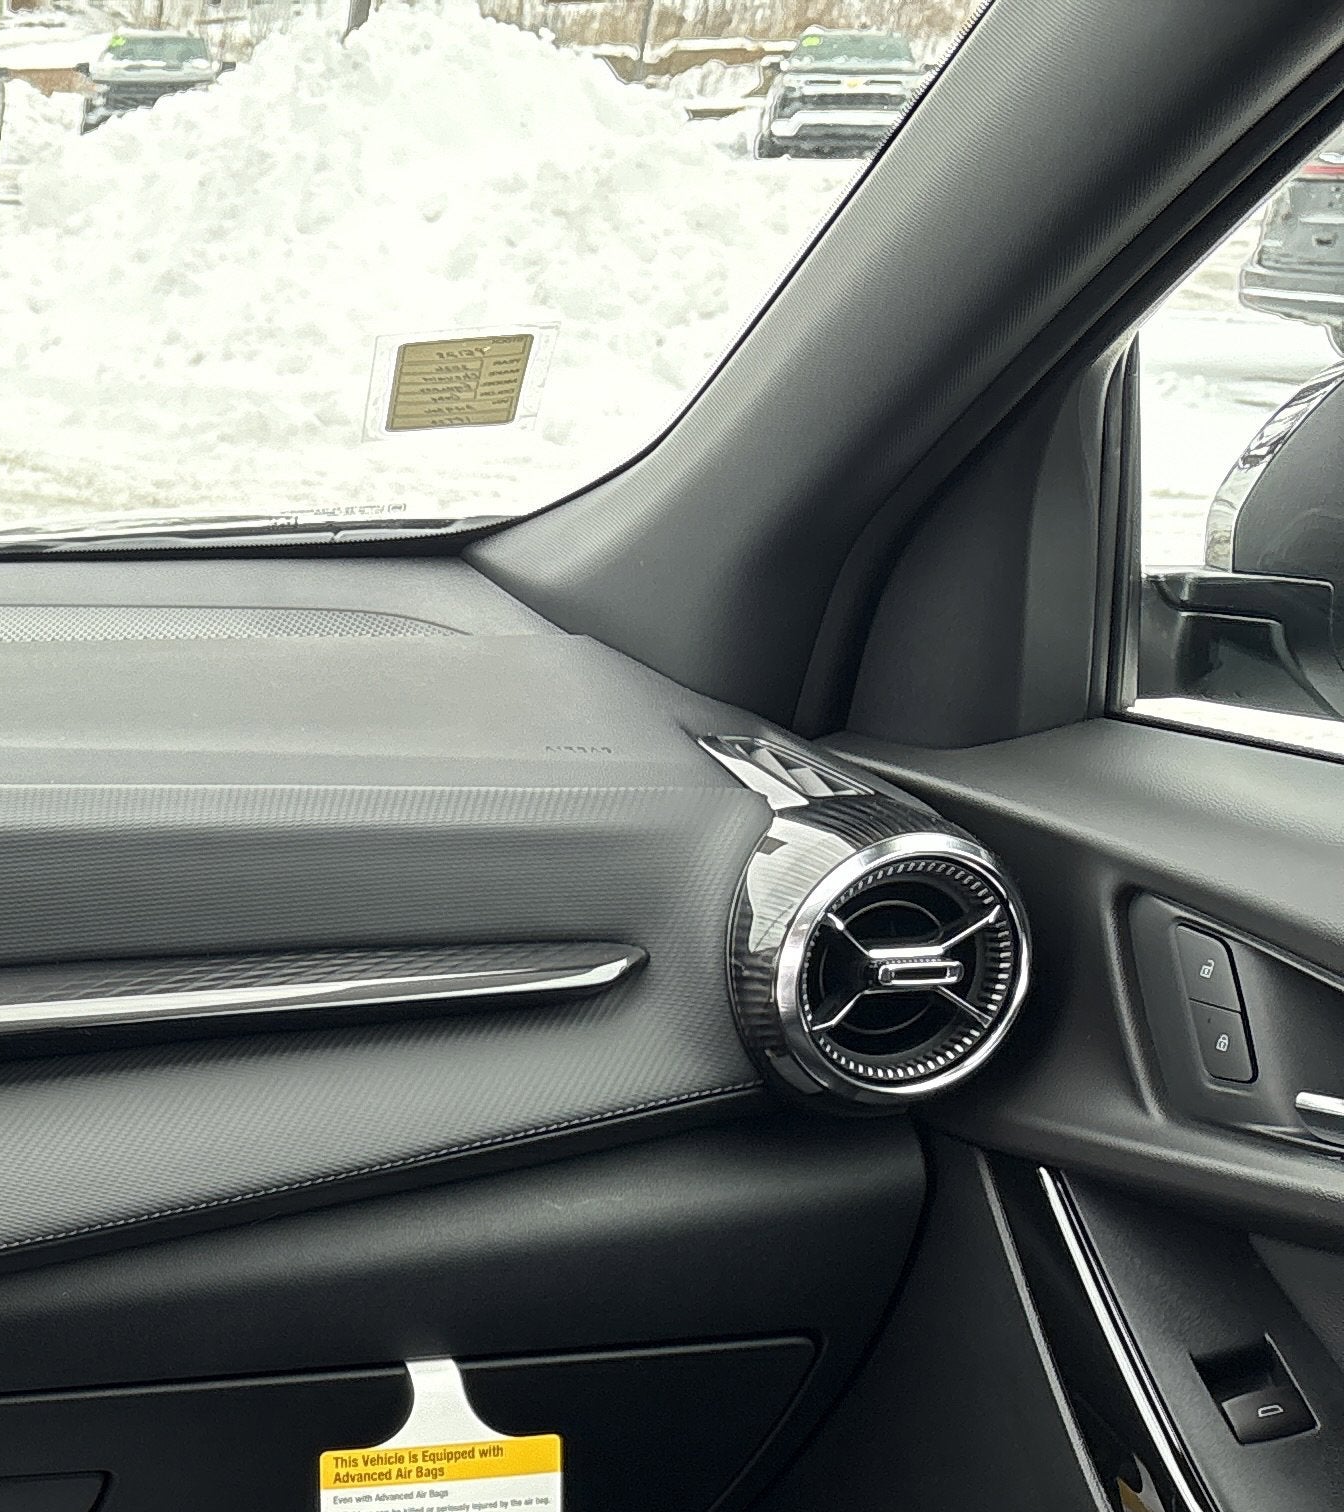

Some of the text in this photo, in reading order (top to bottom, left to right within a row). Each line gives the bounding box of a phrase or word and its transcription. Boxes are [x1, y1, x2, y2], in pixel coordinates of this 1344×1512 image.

[333, 1457, 358, 1469] This
[362, 1453, 404, 1467] Vehicle
[422, 1447, 475, 1463] Equipped
[479, 1445, 503, 1458] with
[333, 1466, 445, 1484] Advanced Air Bags
[333, 1489, 448, 1505] Even with Advanced Air Bags
